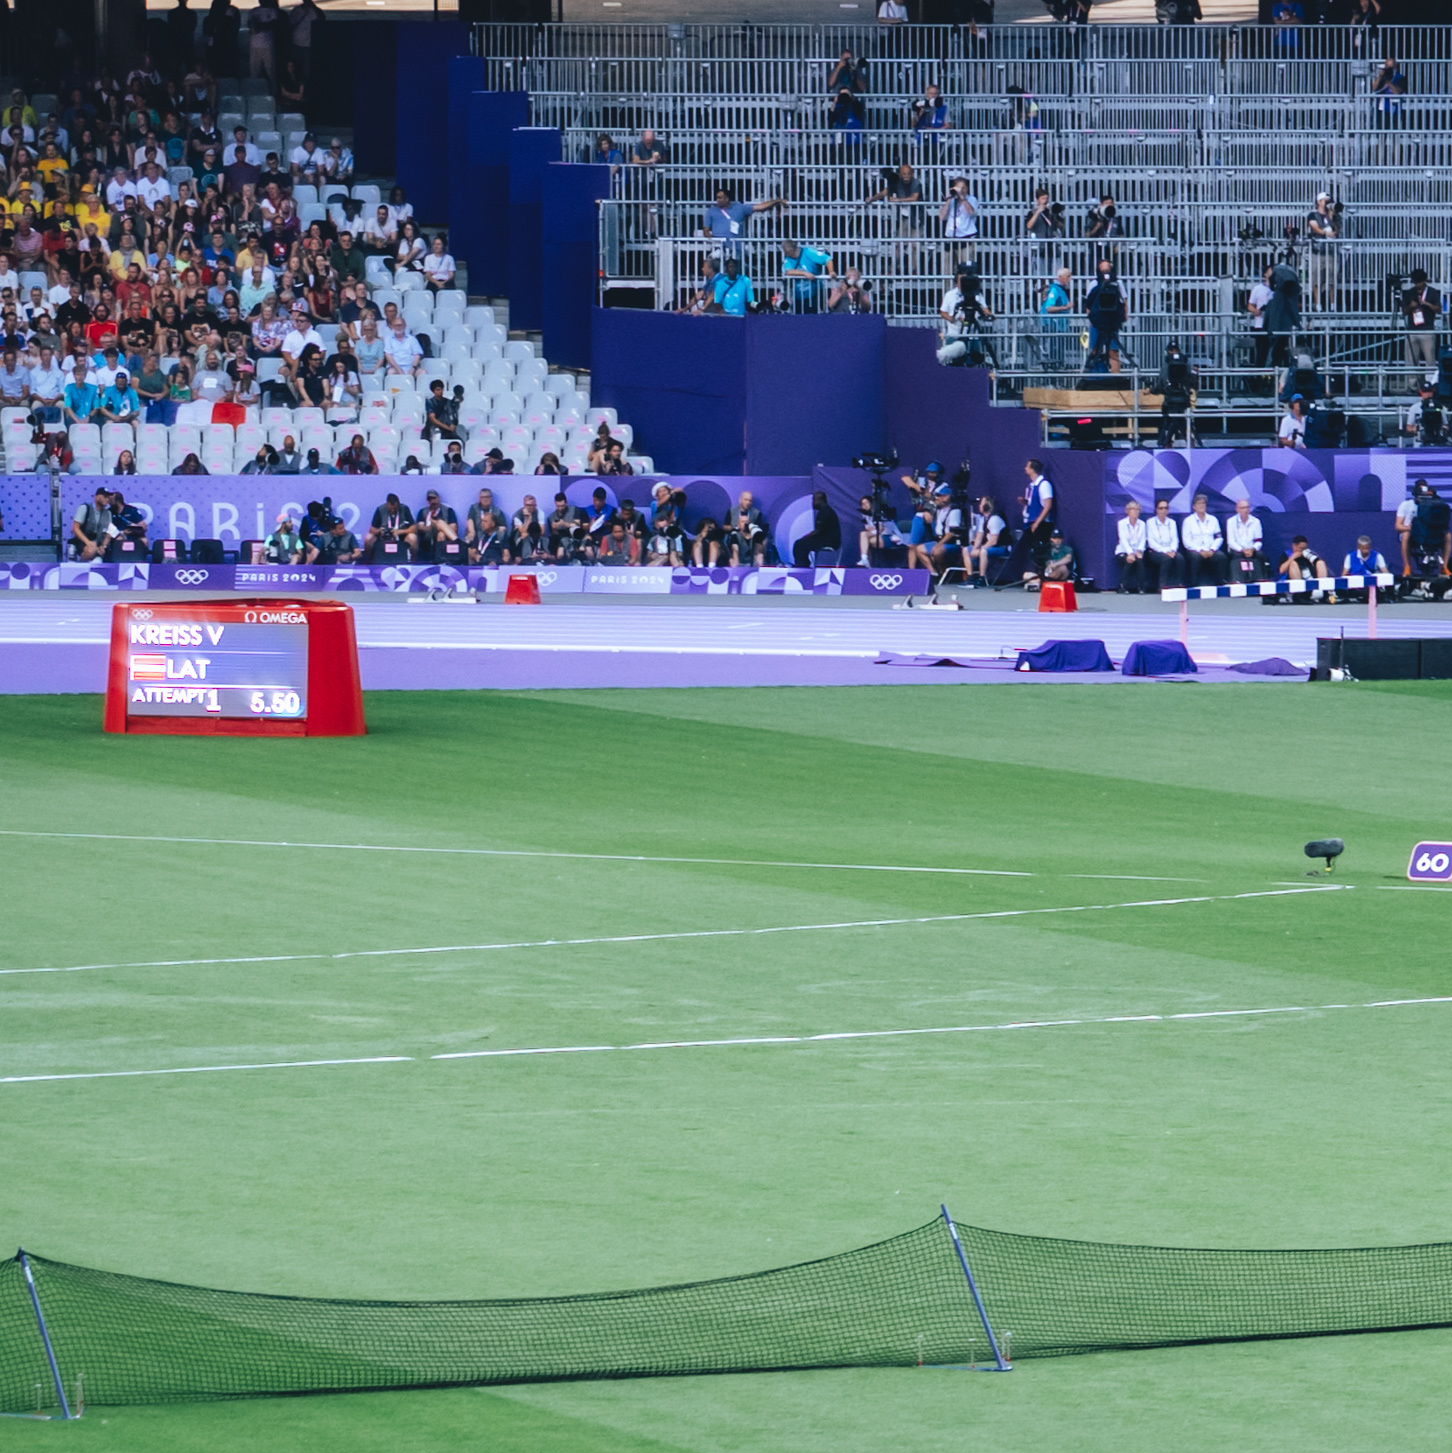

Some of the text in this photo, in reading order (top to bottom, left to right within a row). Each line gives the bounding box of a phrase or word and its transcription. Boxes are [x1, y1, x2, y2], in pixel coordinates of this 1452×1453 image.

[242, 573, 316, 583] PARIS 2024
[591, 574, 664, 585] PARIS 2024
[259, 612, 307, 624] OMEGA
[130, 624, 225, 646] KREISS V
[166, 658, 211, 680] LAT
[132, 688, 300, 715] ATTEMPT 1 5.50
[1415, 852, 1450, 873] 60
